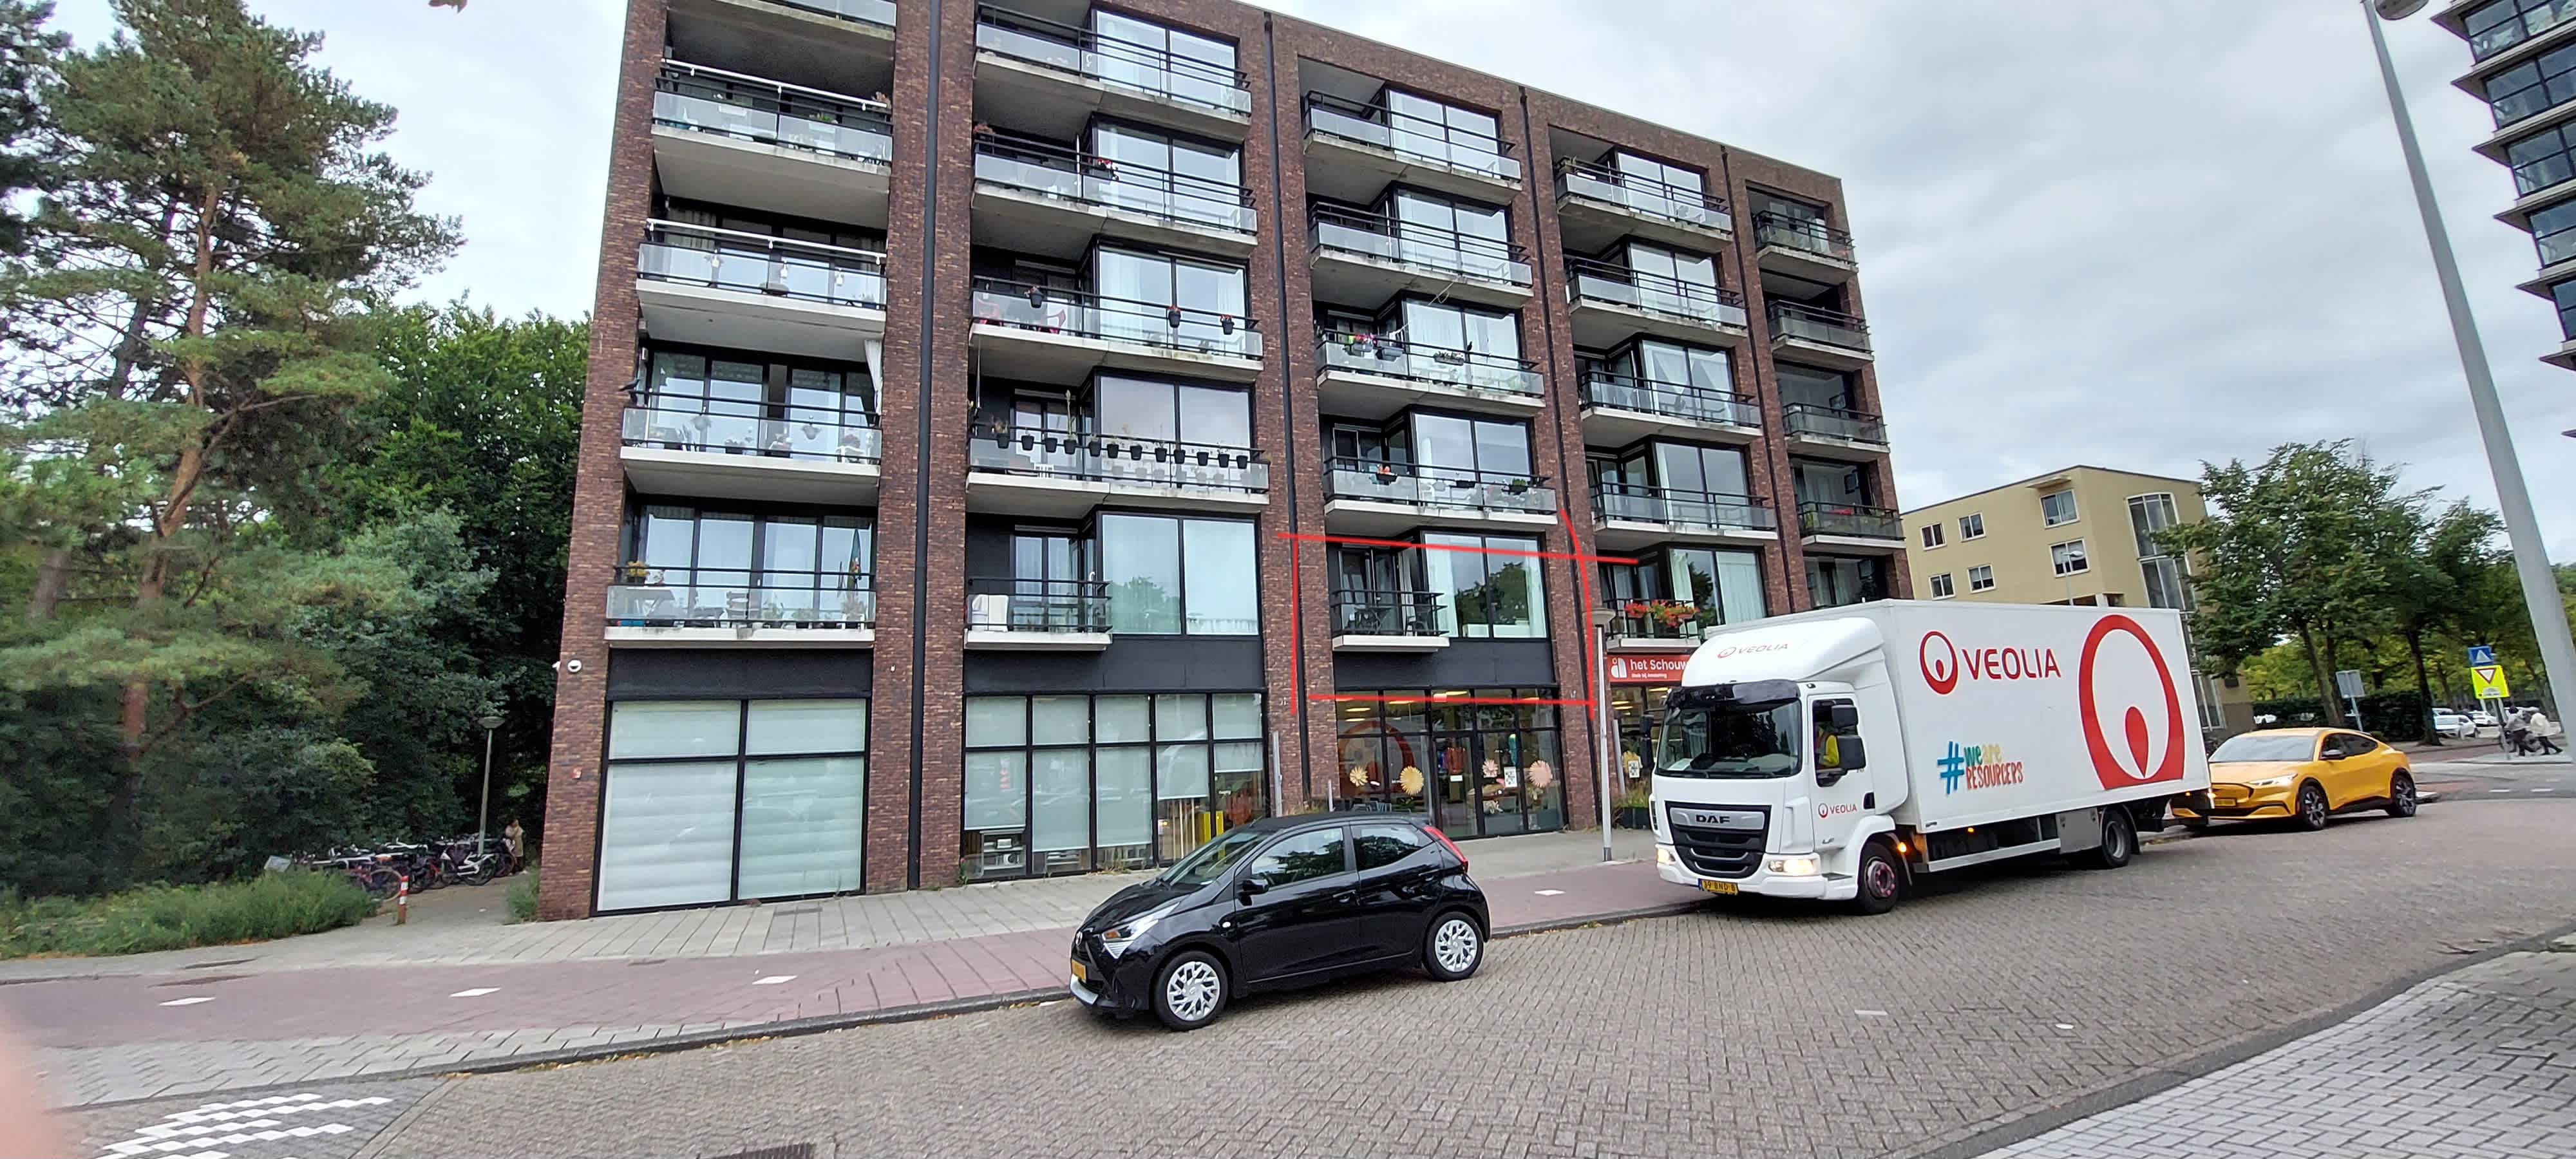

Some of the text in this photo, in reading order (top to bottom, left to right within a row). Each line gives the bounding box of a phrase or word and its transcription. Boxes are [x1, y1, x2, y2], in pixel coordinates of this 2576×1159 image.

[1739, 644, 1788, 654] VEOLIA
[1630, 659, 1647, 670] het
[1962, 648, 2061, 680] VEOLIA
[1830, 804, 1857, 815] VEOLIA
[1696, 815, 1730, 824] DAF
